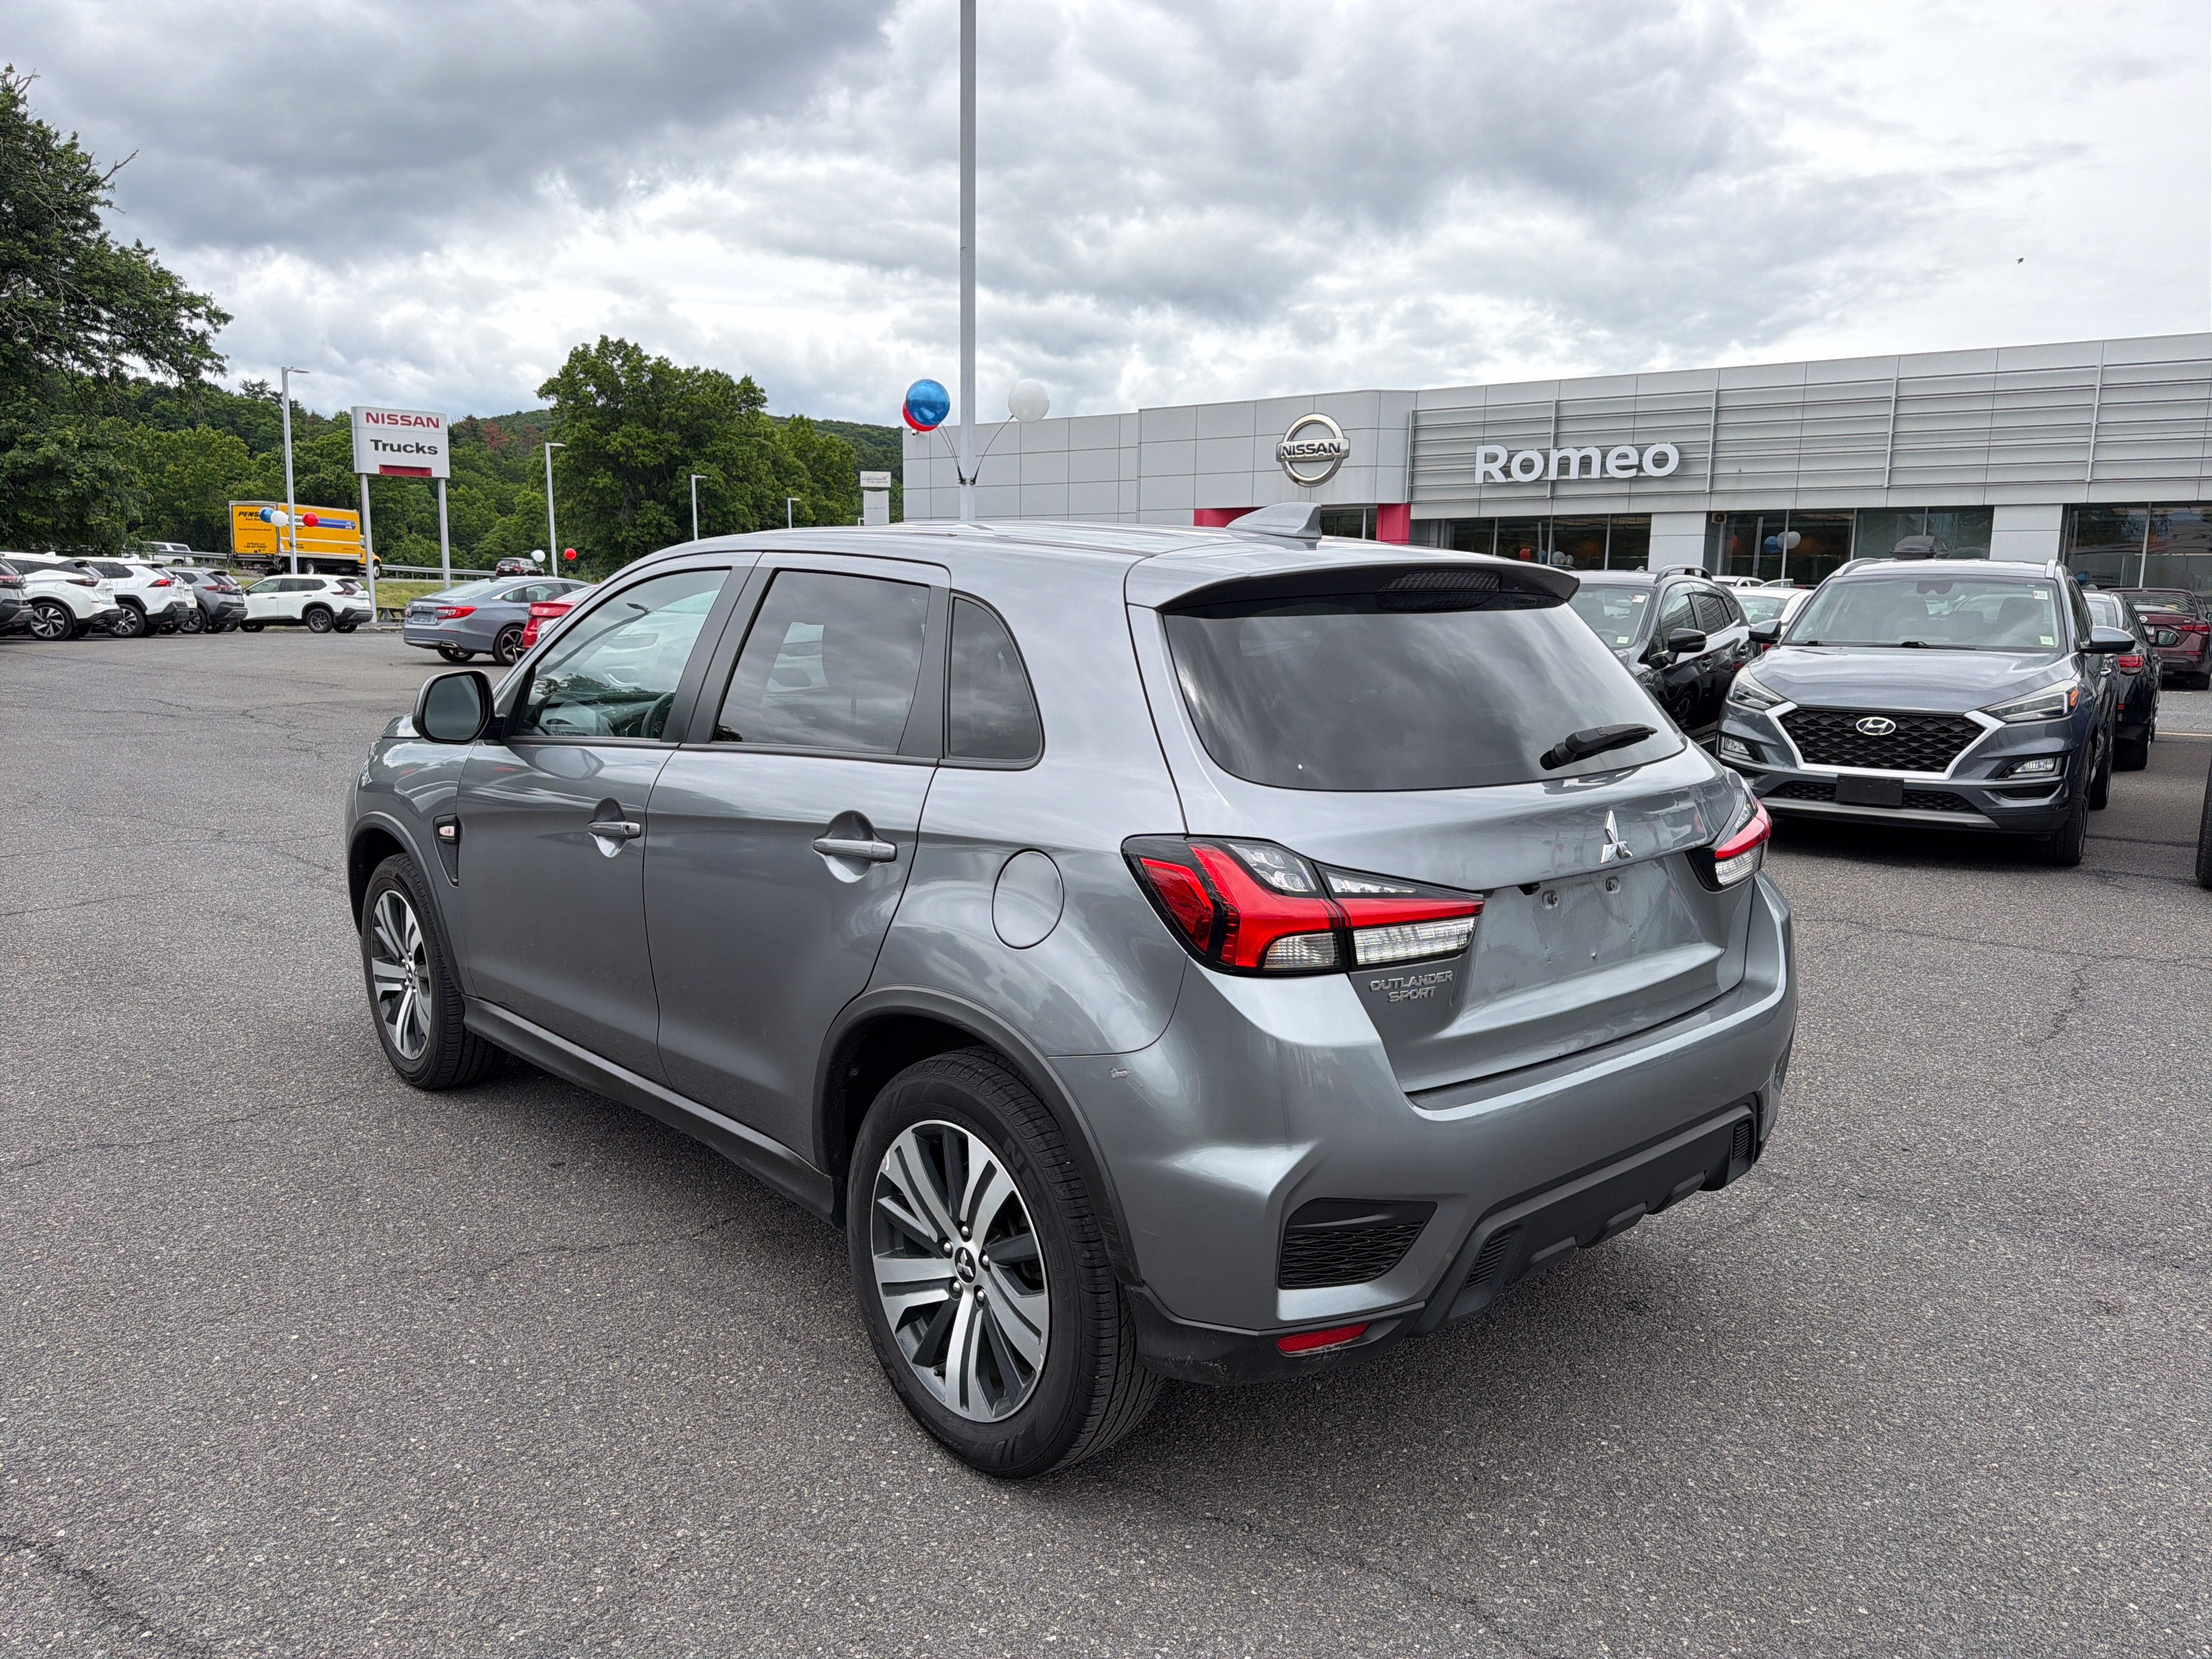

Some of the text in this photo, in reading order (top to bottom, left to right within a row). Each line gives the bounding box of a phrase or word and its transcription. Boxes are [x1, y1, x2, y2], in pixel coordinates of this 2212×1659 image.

[365, 412, 439, 429] NISSAN
[370, 439, 438, 455] Trucks
[1282, 442, 1341, 458] NISSAN
[1474, 443, 1680, 484] Romeo
[1369, 970, 1453, 992] OUTLANDER
[1388, 986, 1437, 1003] SPORT
